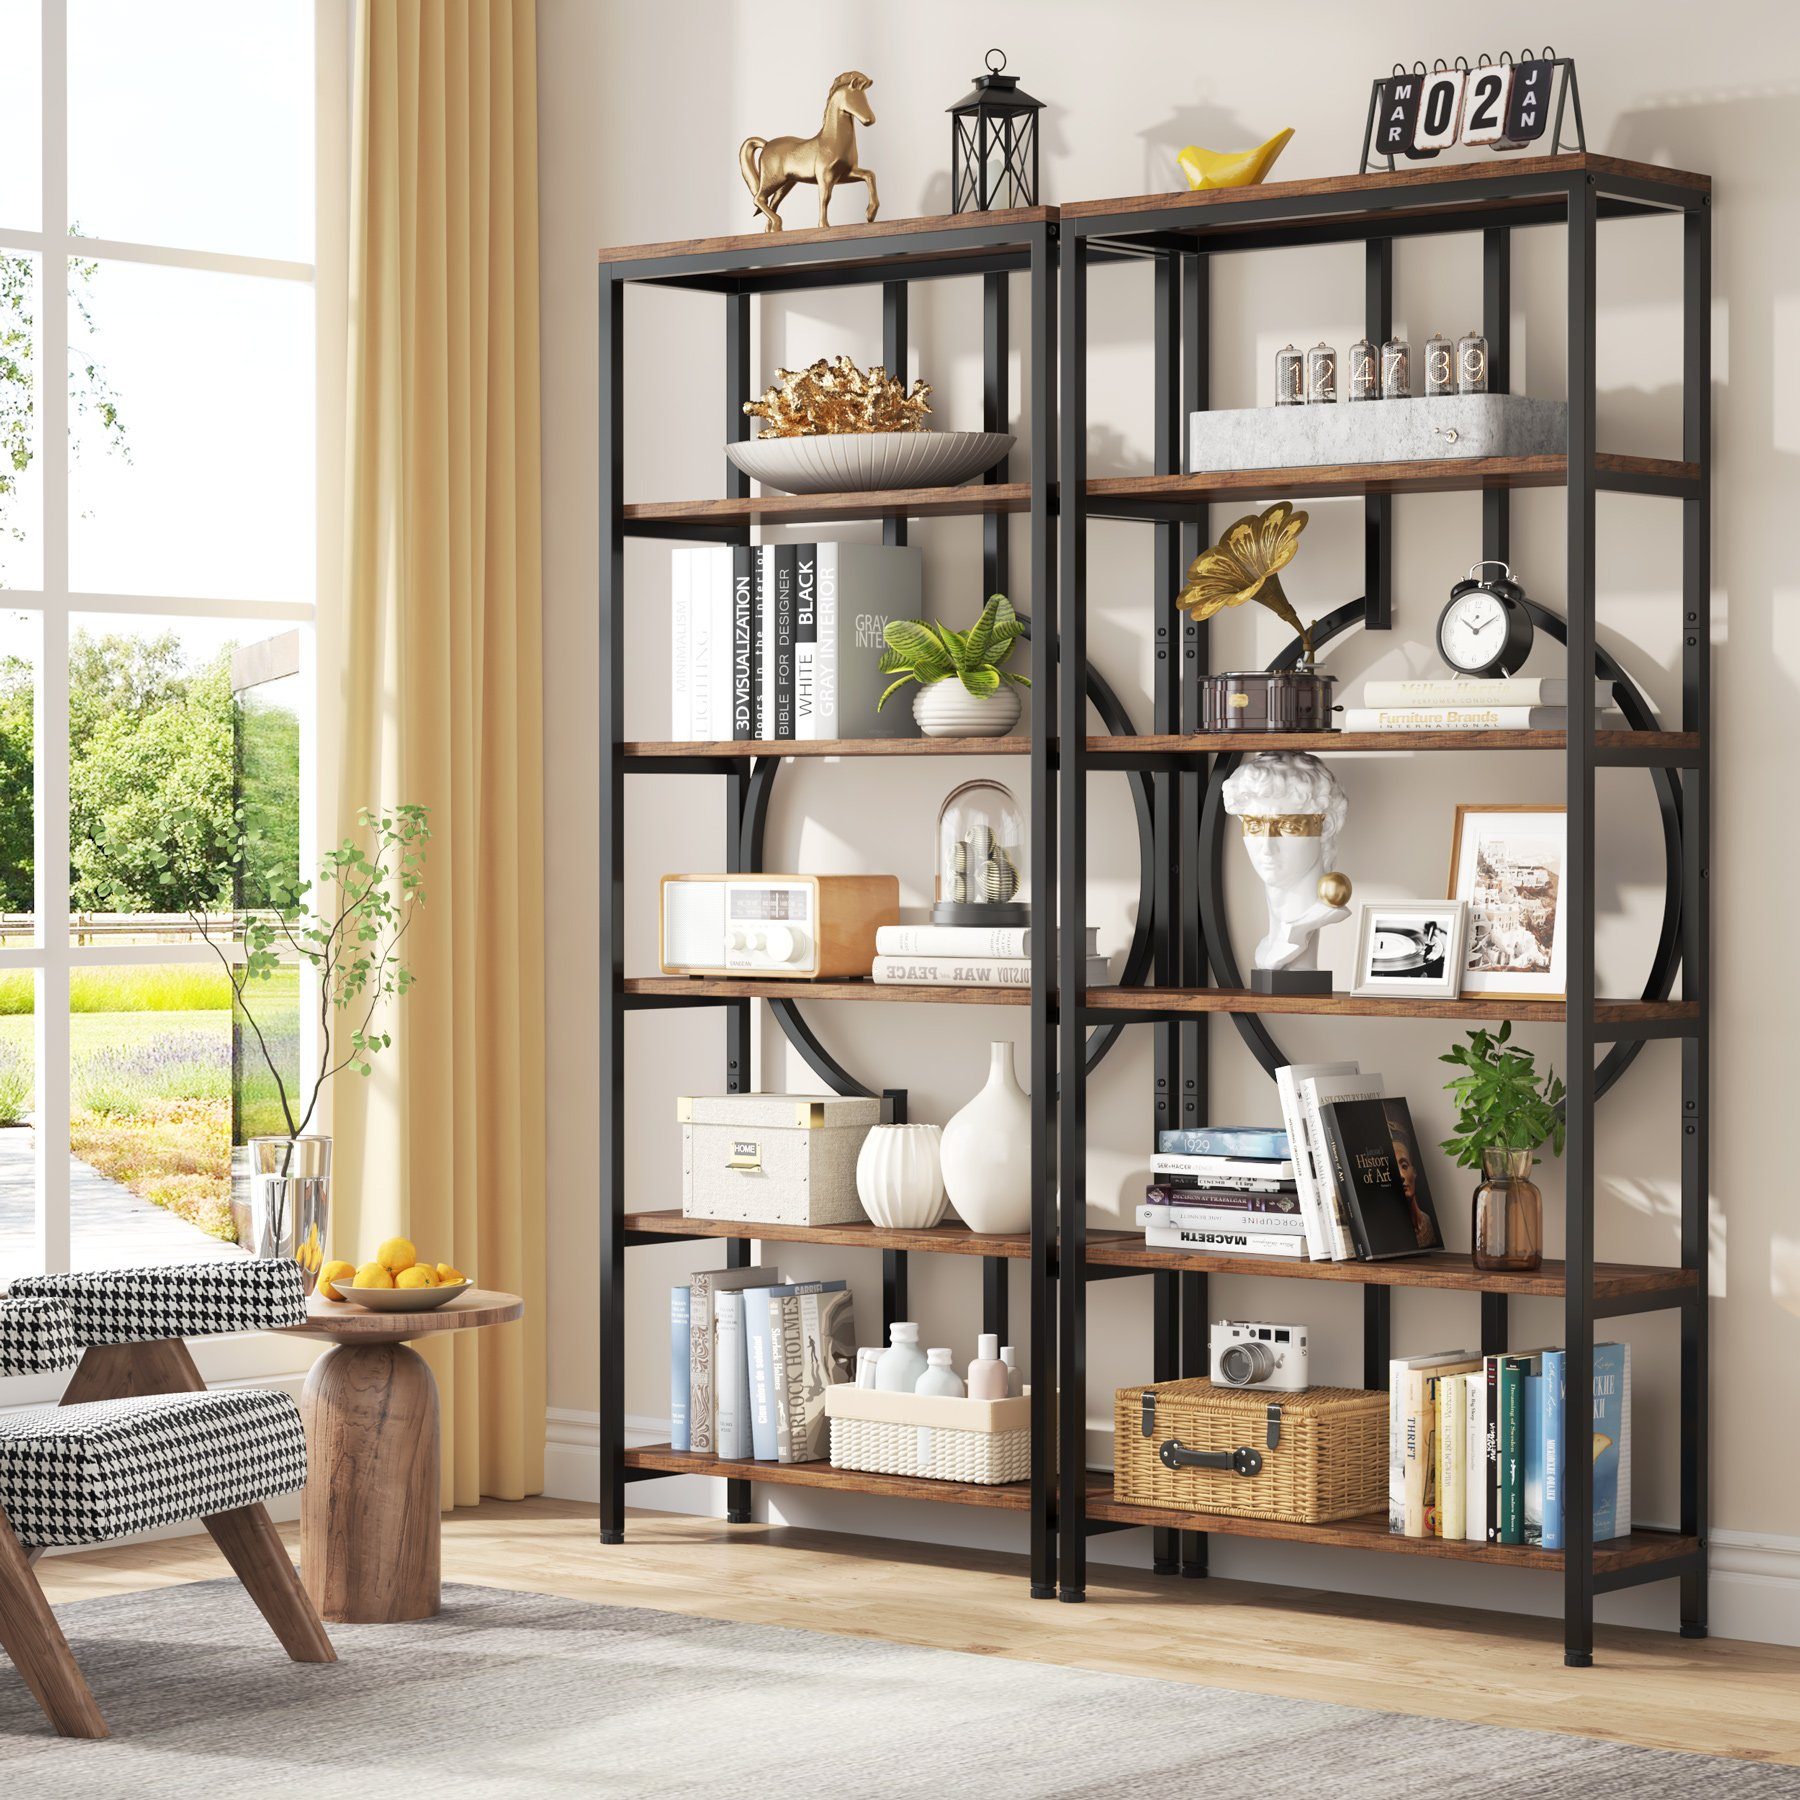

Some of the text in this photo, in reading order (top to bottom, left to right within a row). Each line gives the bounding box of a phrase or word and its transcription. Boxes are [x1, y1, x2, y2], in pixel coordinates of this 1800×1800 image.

[1388, 84, 1412, 142] MAR
[1520, 69, 1538, 128] JAN
[755, 550, 763, 619] interior
[798, 560, 814, 625] BLACK
[676, 601, 688, 692] MINIMALISM
[779, 569, 789, 735] BIBLE FOR DESIGNER
[820, 567, 834, 718] GRAY INTERIOR
[855, 614, 888, 632] GRAY
[695, 630, 708, 733] LIGHTING
[736, 576, 750, 731] 3D VISUALIZATION
[799, 654, 812, 717] WHITE
[755, 694, 763, 738] Doors
[1379, 710, 1499, 723] Furniture Brands
[734, 1143, 756, 1154] HOME
[1184, 1139, 1210, 1153] 1929
[1355, 1154, 1389, 1169] History
[1209, 1195, 1247, 1204] TRAFALGAR
[1363, 1168, 1392, 1184] of Art
[1180, 1231, 1247, 1246] MACBETH
[1241, 1216, 1304, 1228] PORCUPINE
[771, 1328, 784, 1391] Sherlock Holmes
[783, 1296, 809, 1463] SHERLOCK HOLMES
[1407, 1417, 1416, 1460] THRIFT
